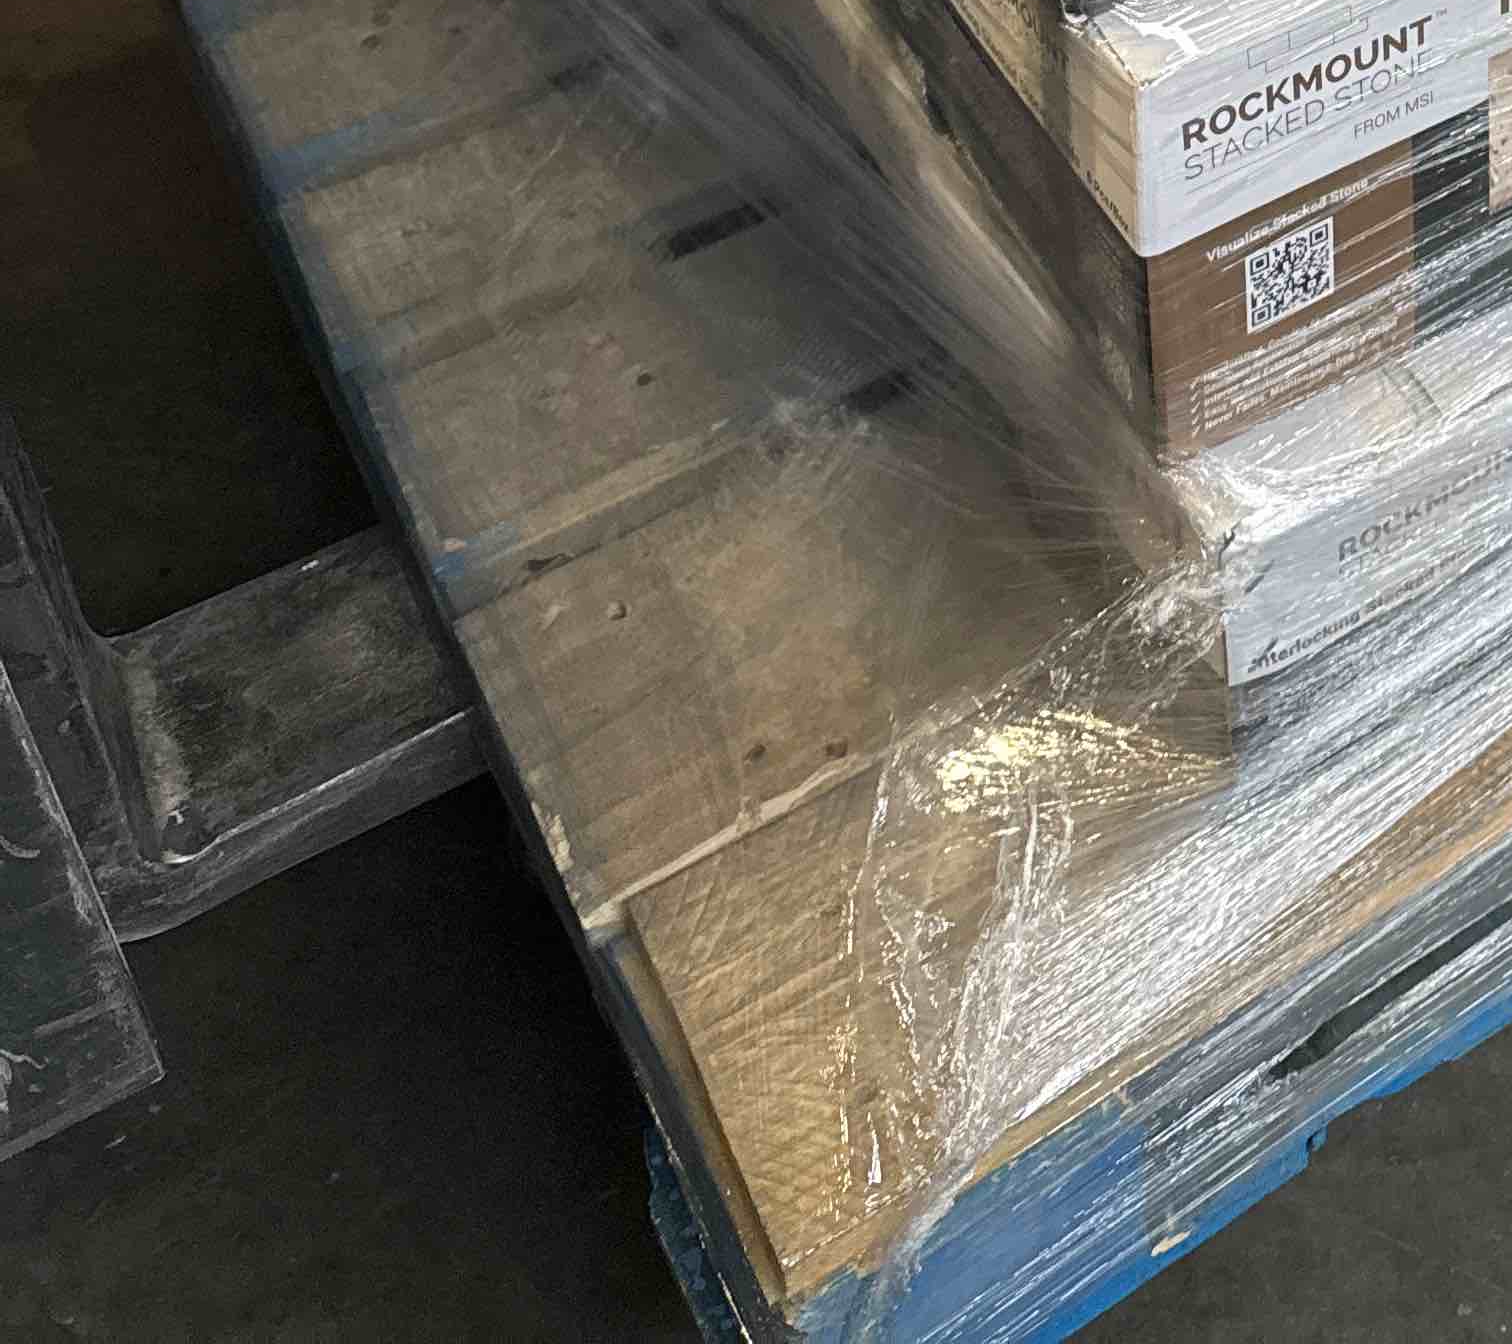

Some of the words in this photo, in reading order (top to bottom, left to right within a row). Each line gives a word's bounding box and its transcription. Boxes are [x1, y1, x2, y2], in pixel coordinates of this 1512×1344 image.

[1181, 15, 1433, 153] ROCKMOUNT
[1182, 95, 1326, 182] STACKED
[1333, 50, 1437, 115] STONE
[1352, 106, 1401, 140] FROM
[1403, 91, 1435, 119] MSI
[1205, 219, 1270, 262] Visualize
[1271, 192, 1329, 235] Stacked
[1330, 176, 1370, 206] Stone
